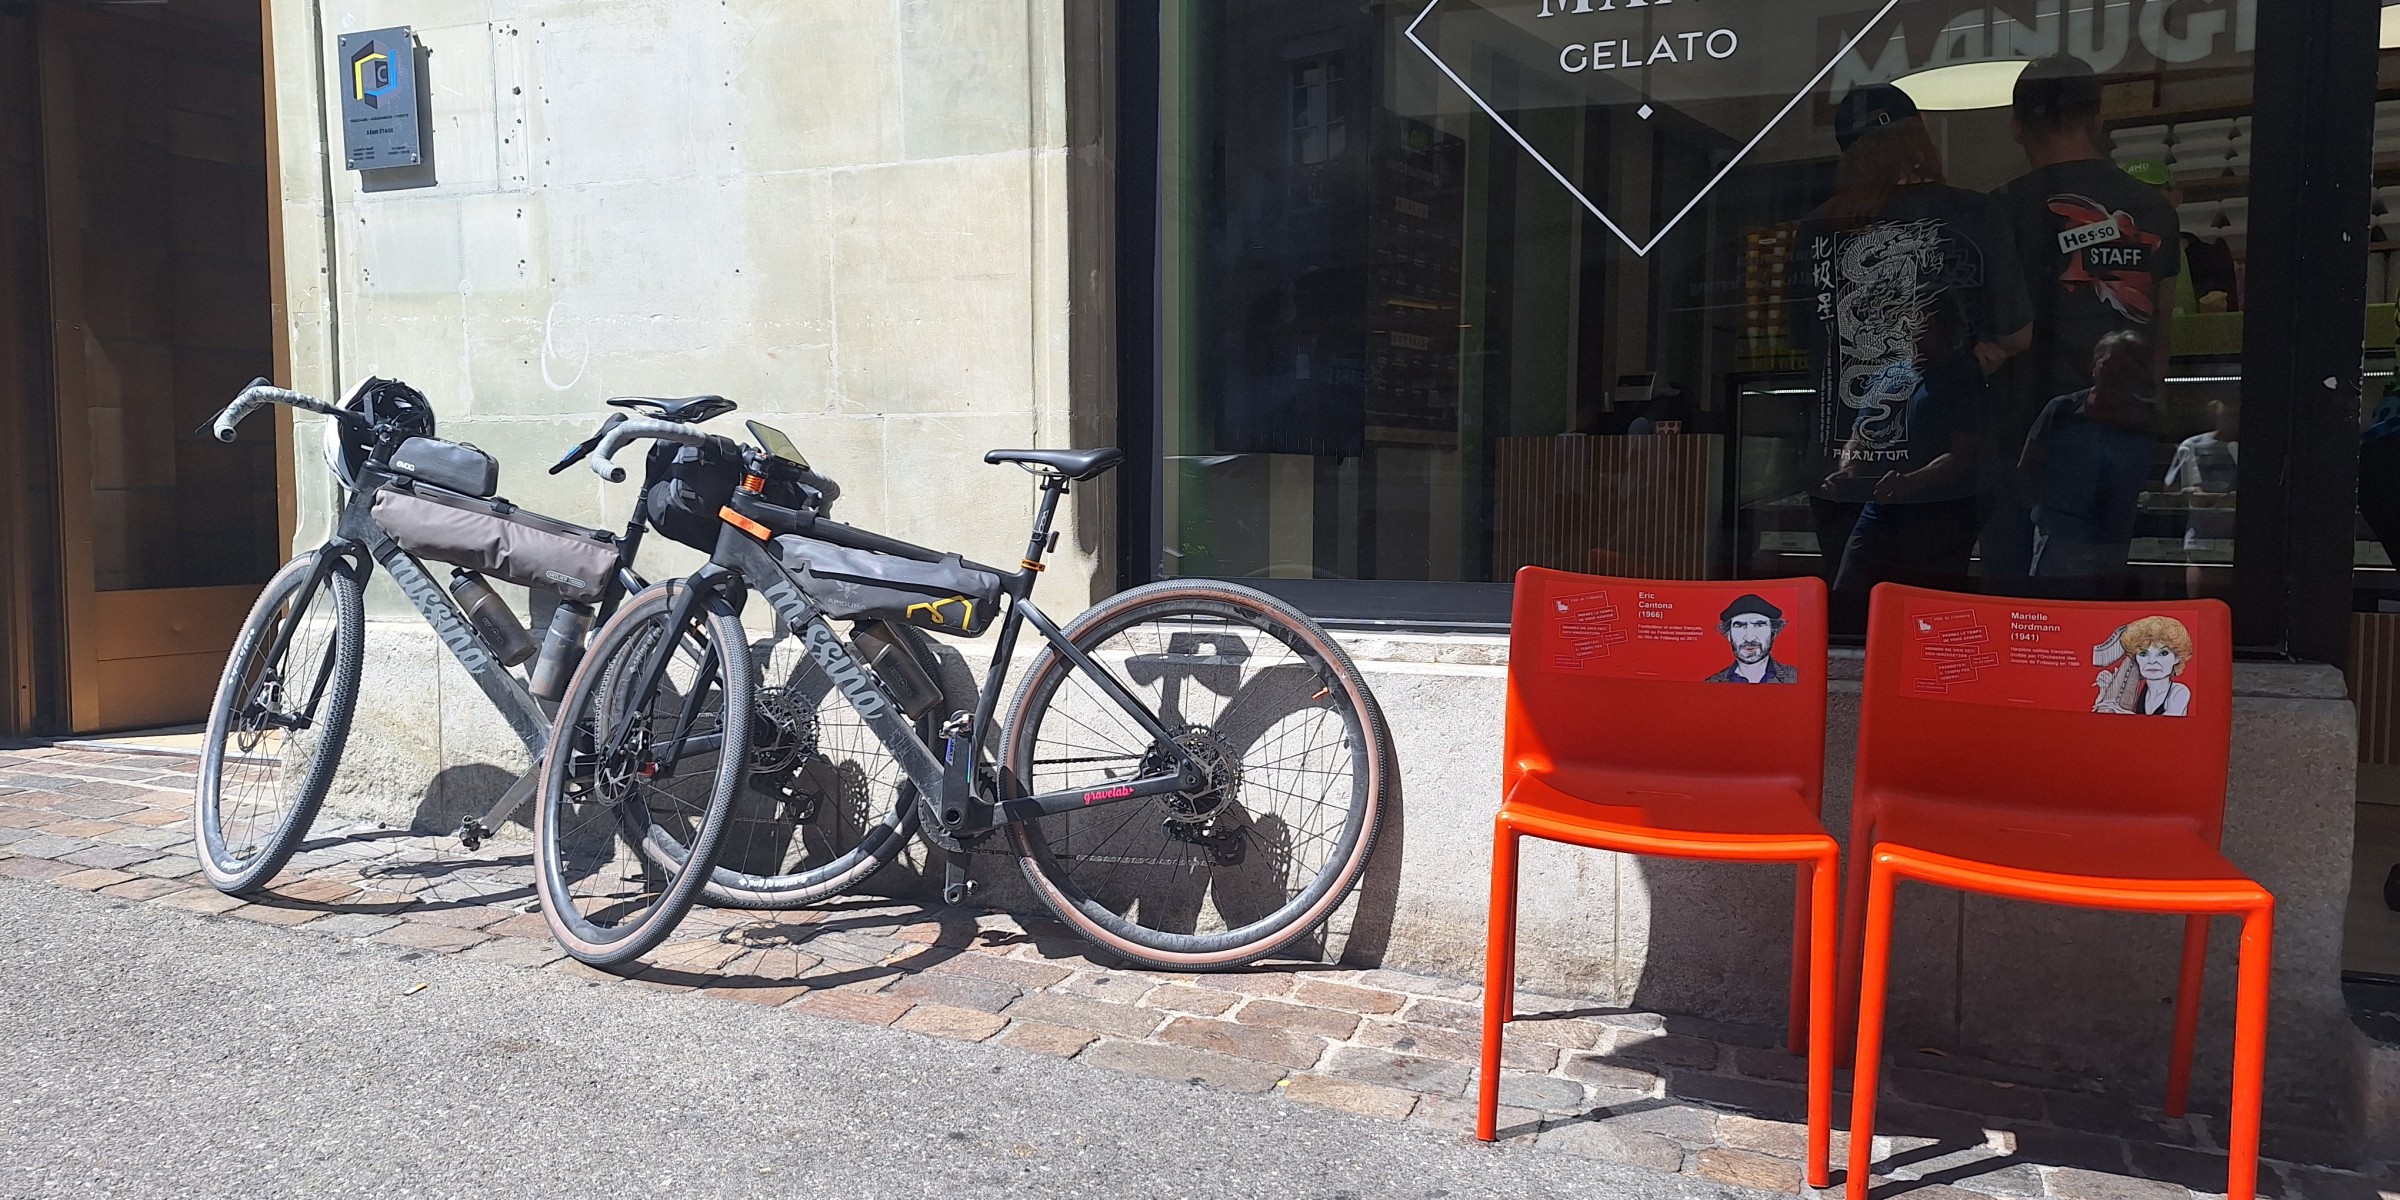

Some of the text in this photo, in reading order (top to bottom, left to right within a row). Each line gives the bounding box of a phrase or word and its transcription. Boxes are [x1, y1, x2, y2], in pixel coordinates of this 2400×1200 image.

[1559, 28, 1739, 74] GELATO
[2125, 163, 2150, 173] ANU
[2090, 247, 2143, 266] STAFF
[1833, 448, 1909, 461] PHANTOM
[1638, 591, 1656, 599] Eric
[827, 598, 867, 610] APIDURA
[1638, 601, 1674, 609] Cantona
[1638, 610, 1664, 620] (1966)
[2011, 612, 2048, 621] Marielle
[2011, 622, 2061, 632] Nordmann
[2010, 632, 2039, 642] (1941)
[765, 580, 885, 719] mssina
[1084, 785, 1128, 805] gravelab
